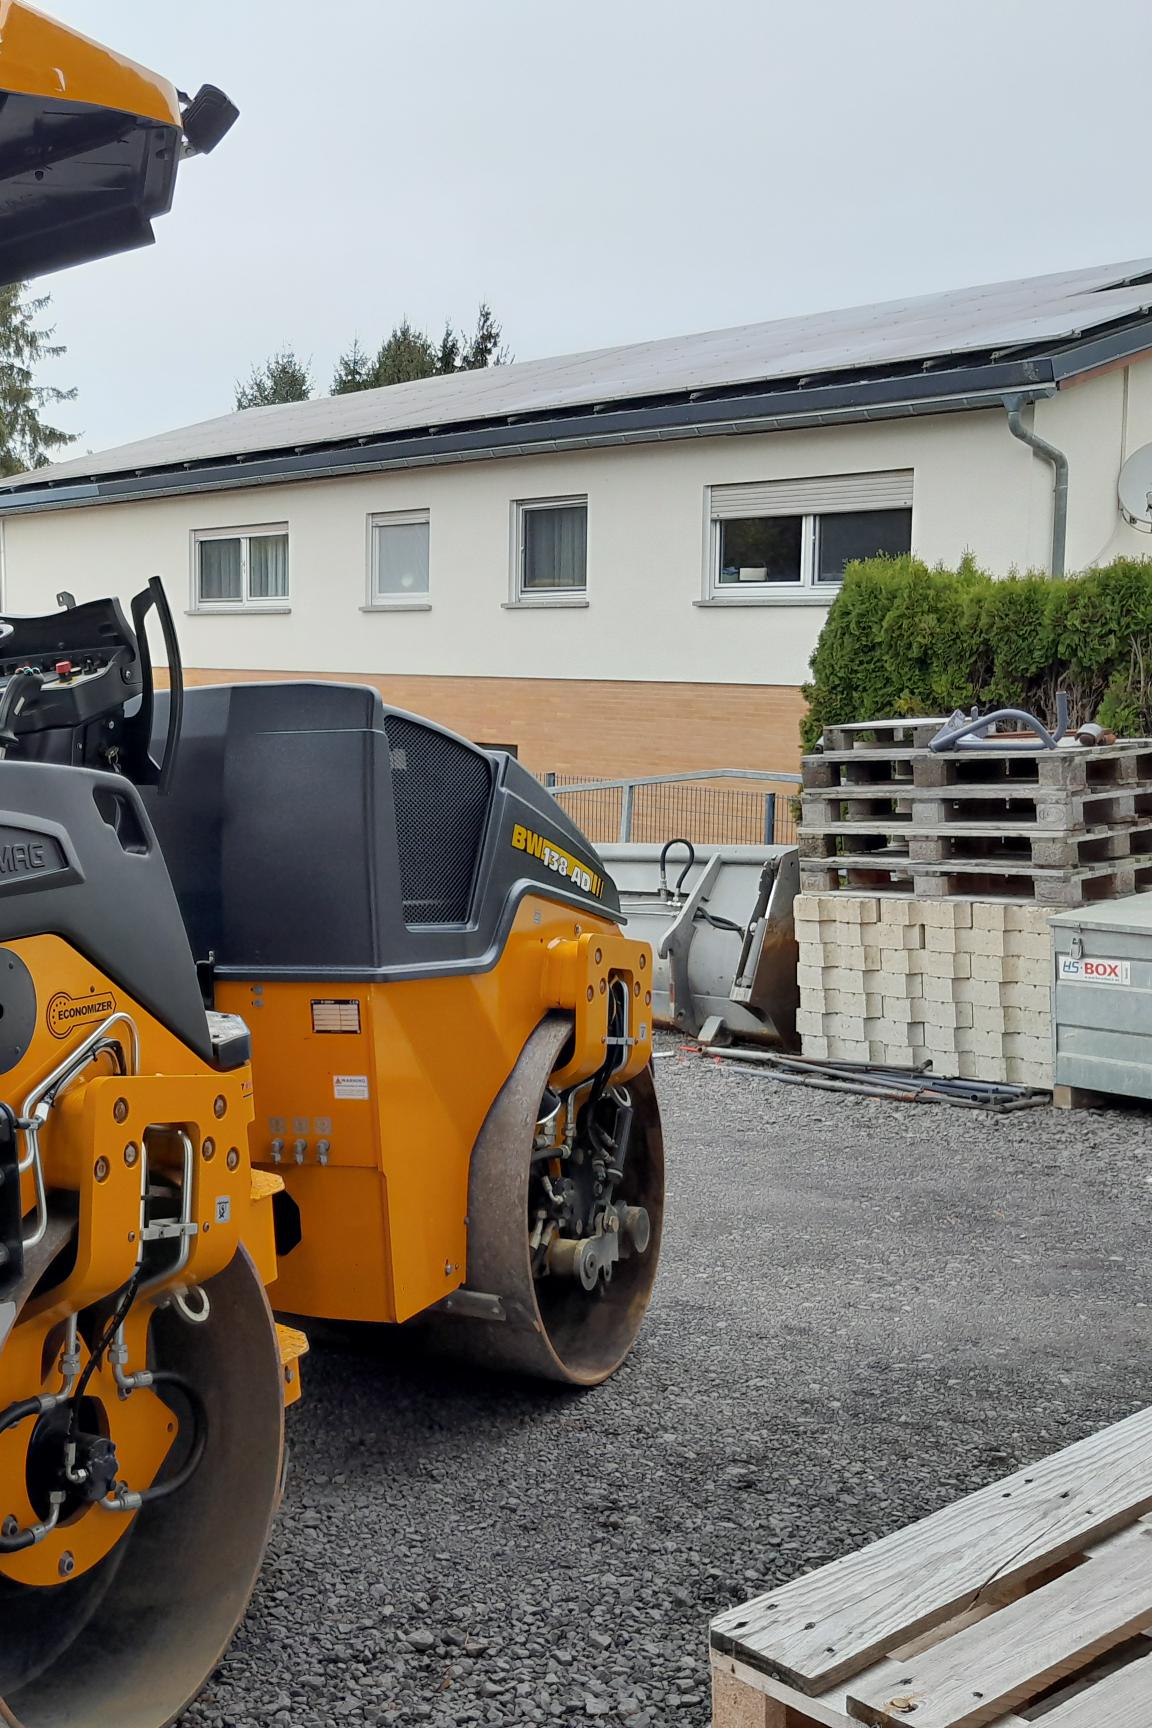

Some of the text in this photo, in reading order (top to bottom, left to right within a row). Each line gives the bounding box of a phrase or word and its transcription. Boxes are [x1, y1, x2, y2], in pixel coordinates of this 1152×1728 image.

[511, 823, 591, 892] BW 138 AD
[58, 1000, 113, 1020] ECONOMIZER
